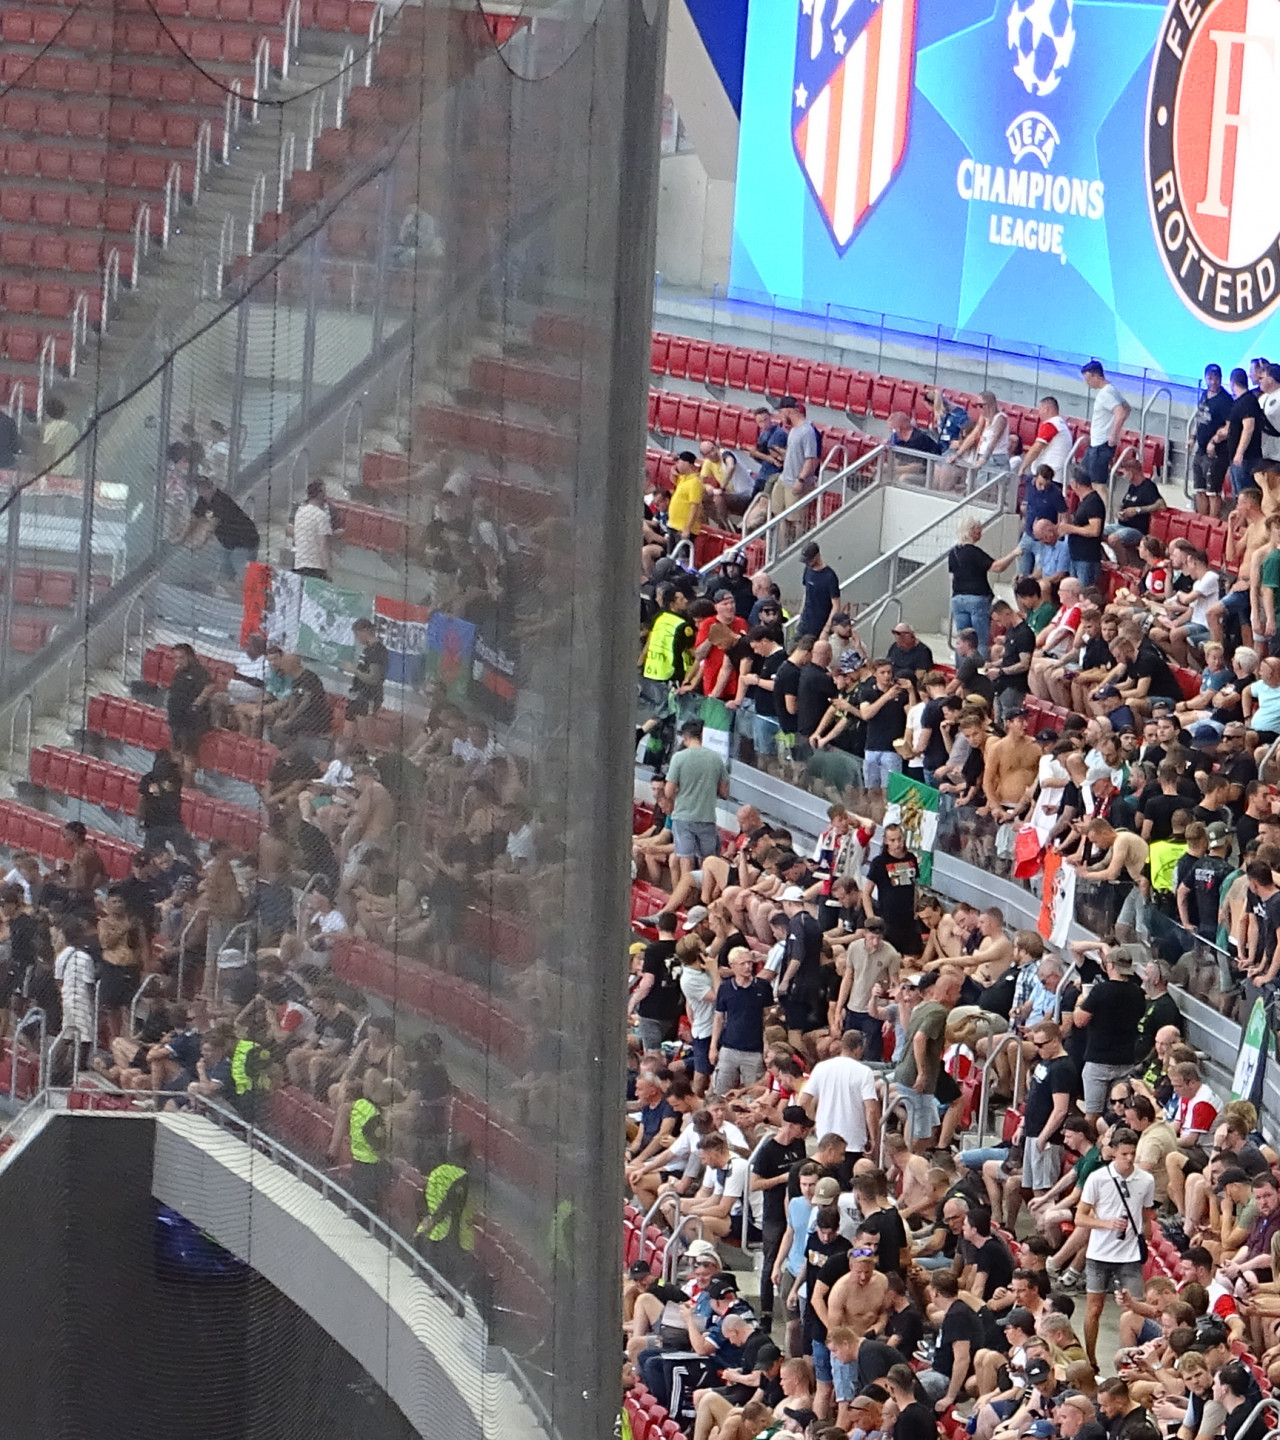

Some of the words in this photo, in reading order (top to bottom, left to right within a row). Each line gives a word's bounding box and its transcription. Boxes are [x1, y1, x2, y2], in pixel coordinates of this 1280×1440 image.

[1008, 120, 1055, 162] UEFA
[957, 158, 1104, 220] CHAMPIONS
[989, 214, 1064, 254] LEAGUE
